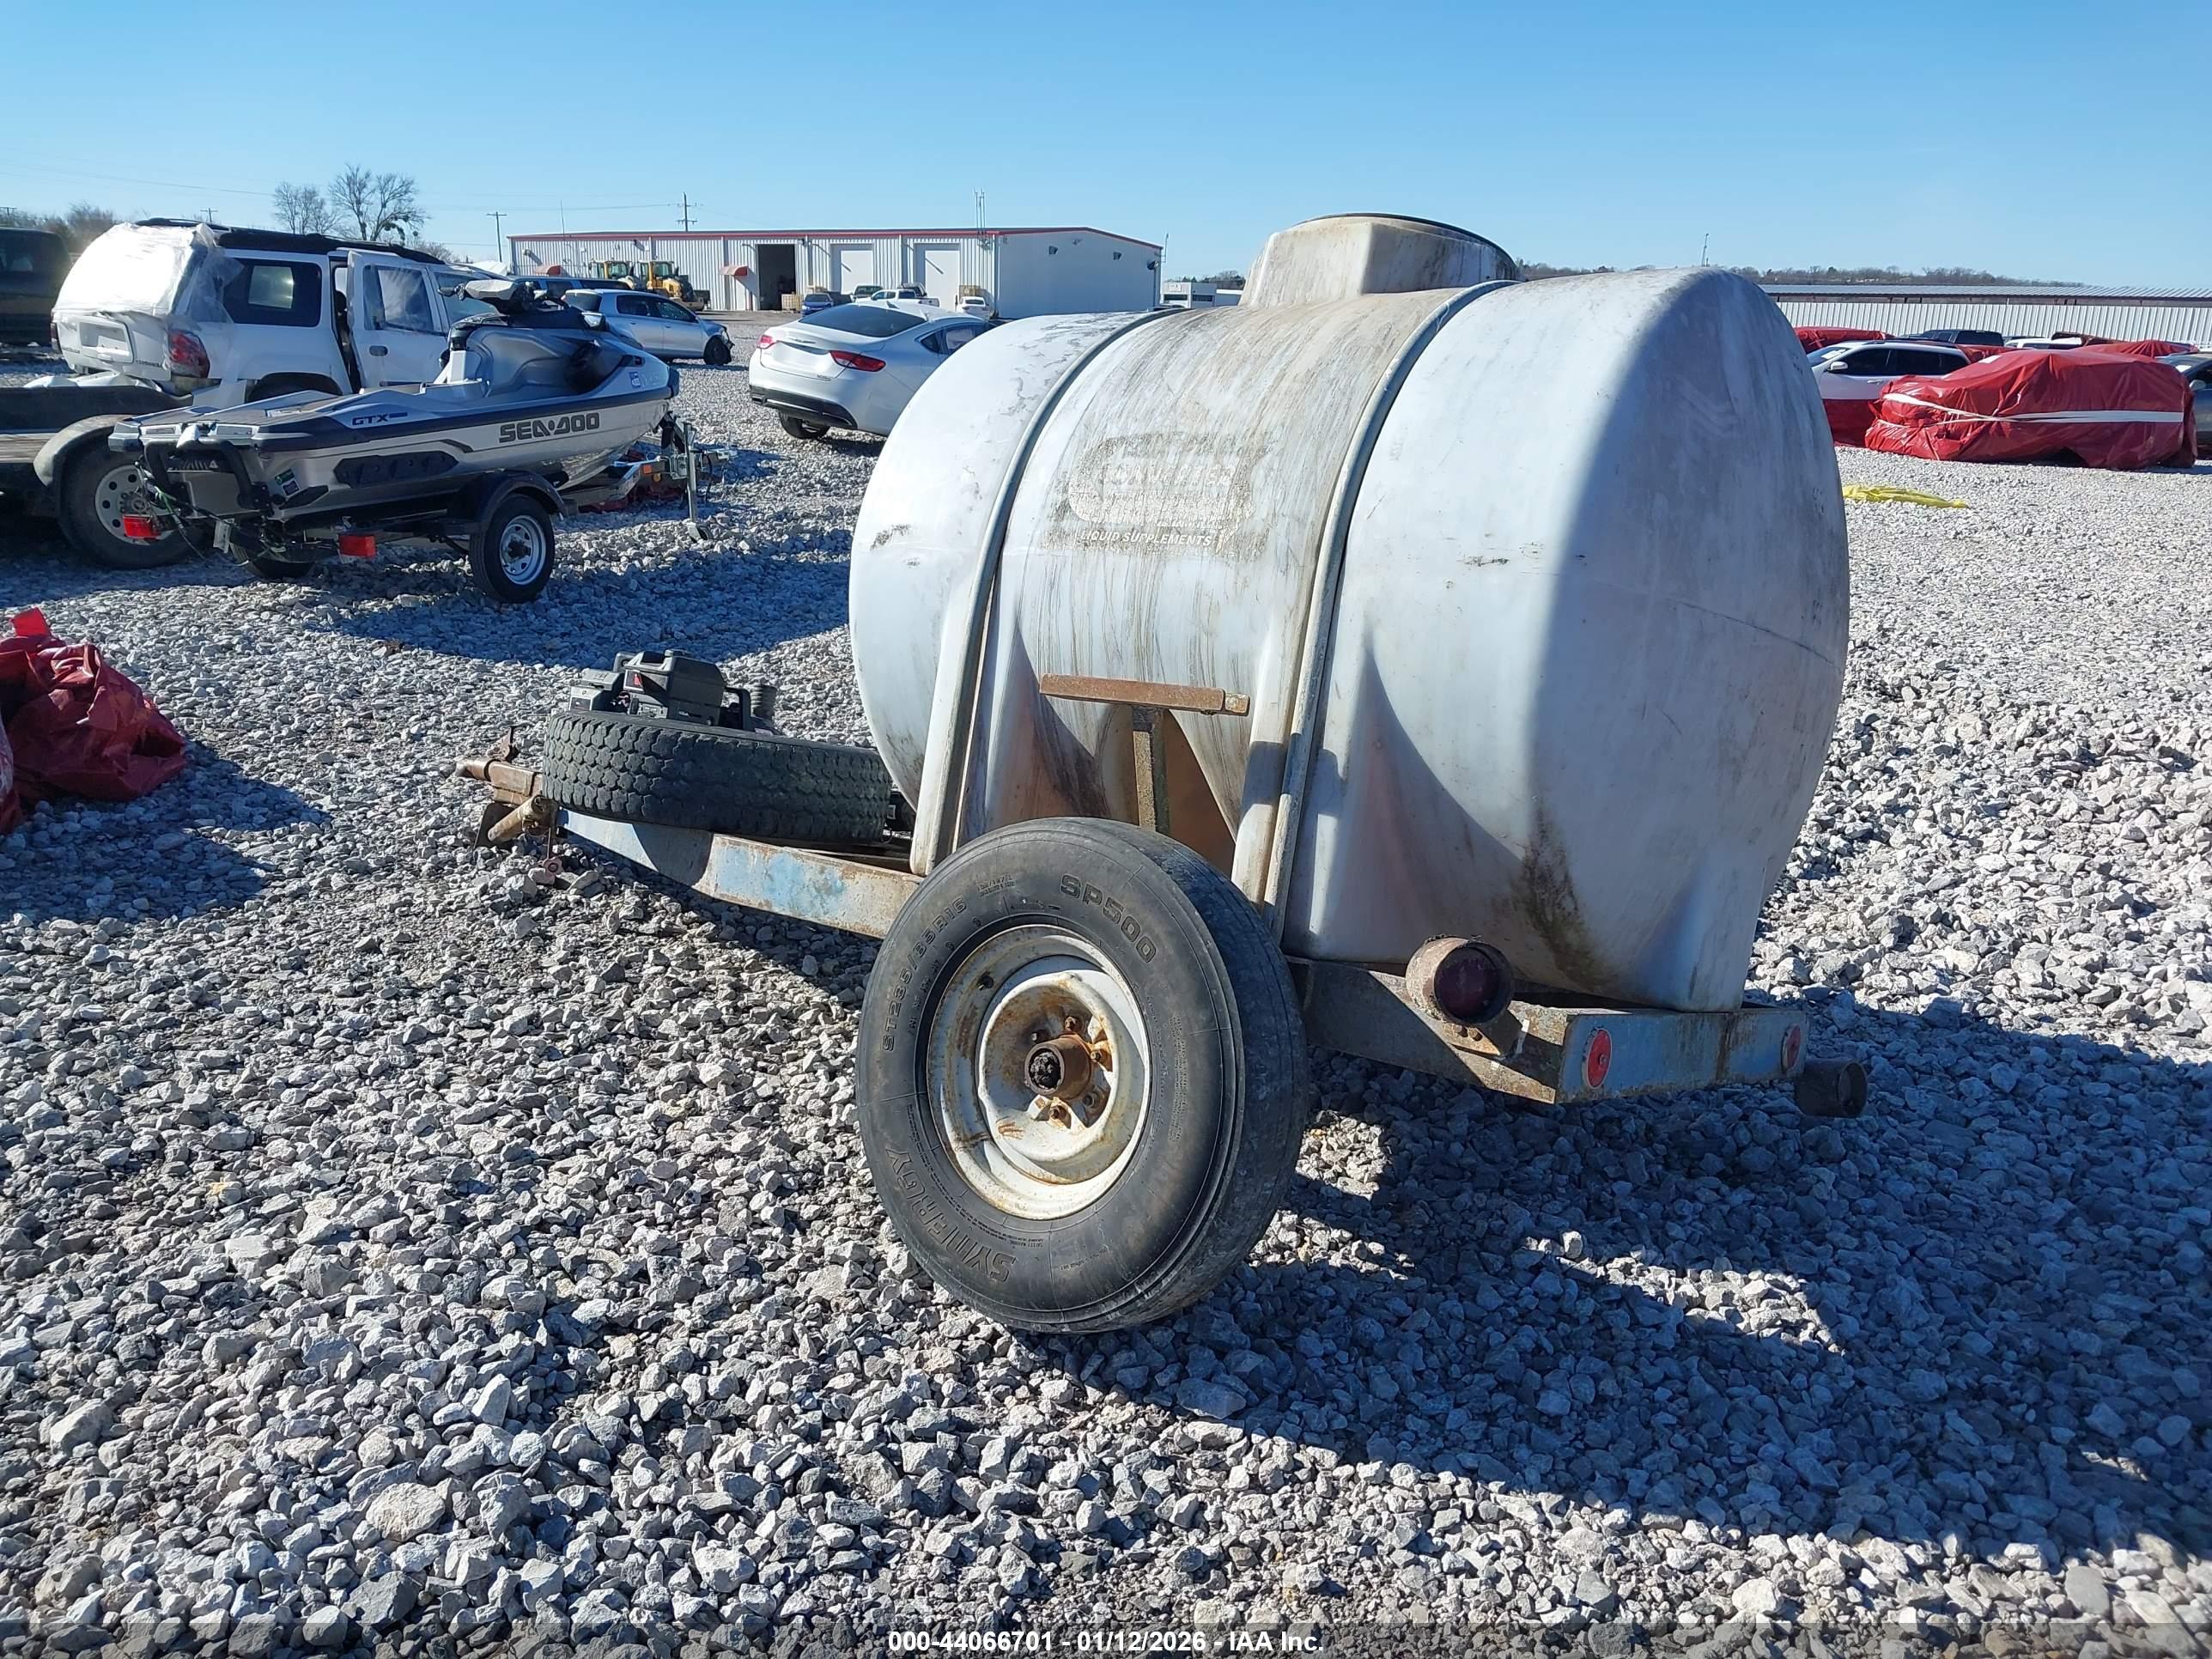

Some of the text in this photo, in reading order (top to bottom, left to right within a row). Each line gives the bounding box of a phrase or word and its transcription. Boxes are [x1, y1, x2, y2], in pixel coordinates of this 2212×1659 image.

[351, 414, 388, 426] GTX
[1080, 530, 1213, 547] LIQUID SUPPLEMENTS
[1060, 874, 1157, 963] SP500
[882, 895, 968, 1052] ST235/85R16
[885, 1148, 1017, 1283] SYNERGY
